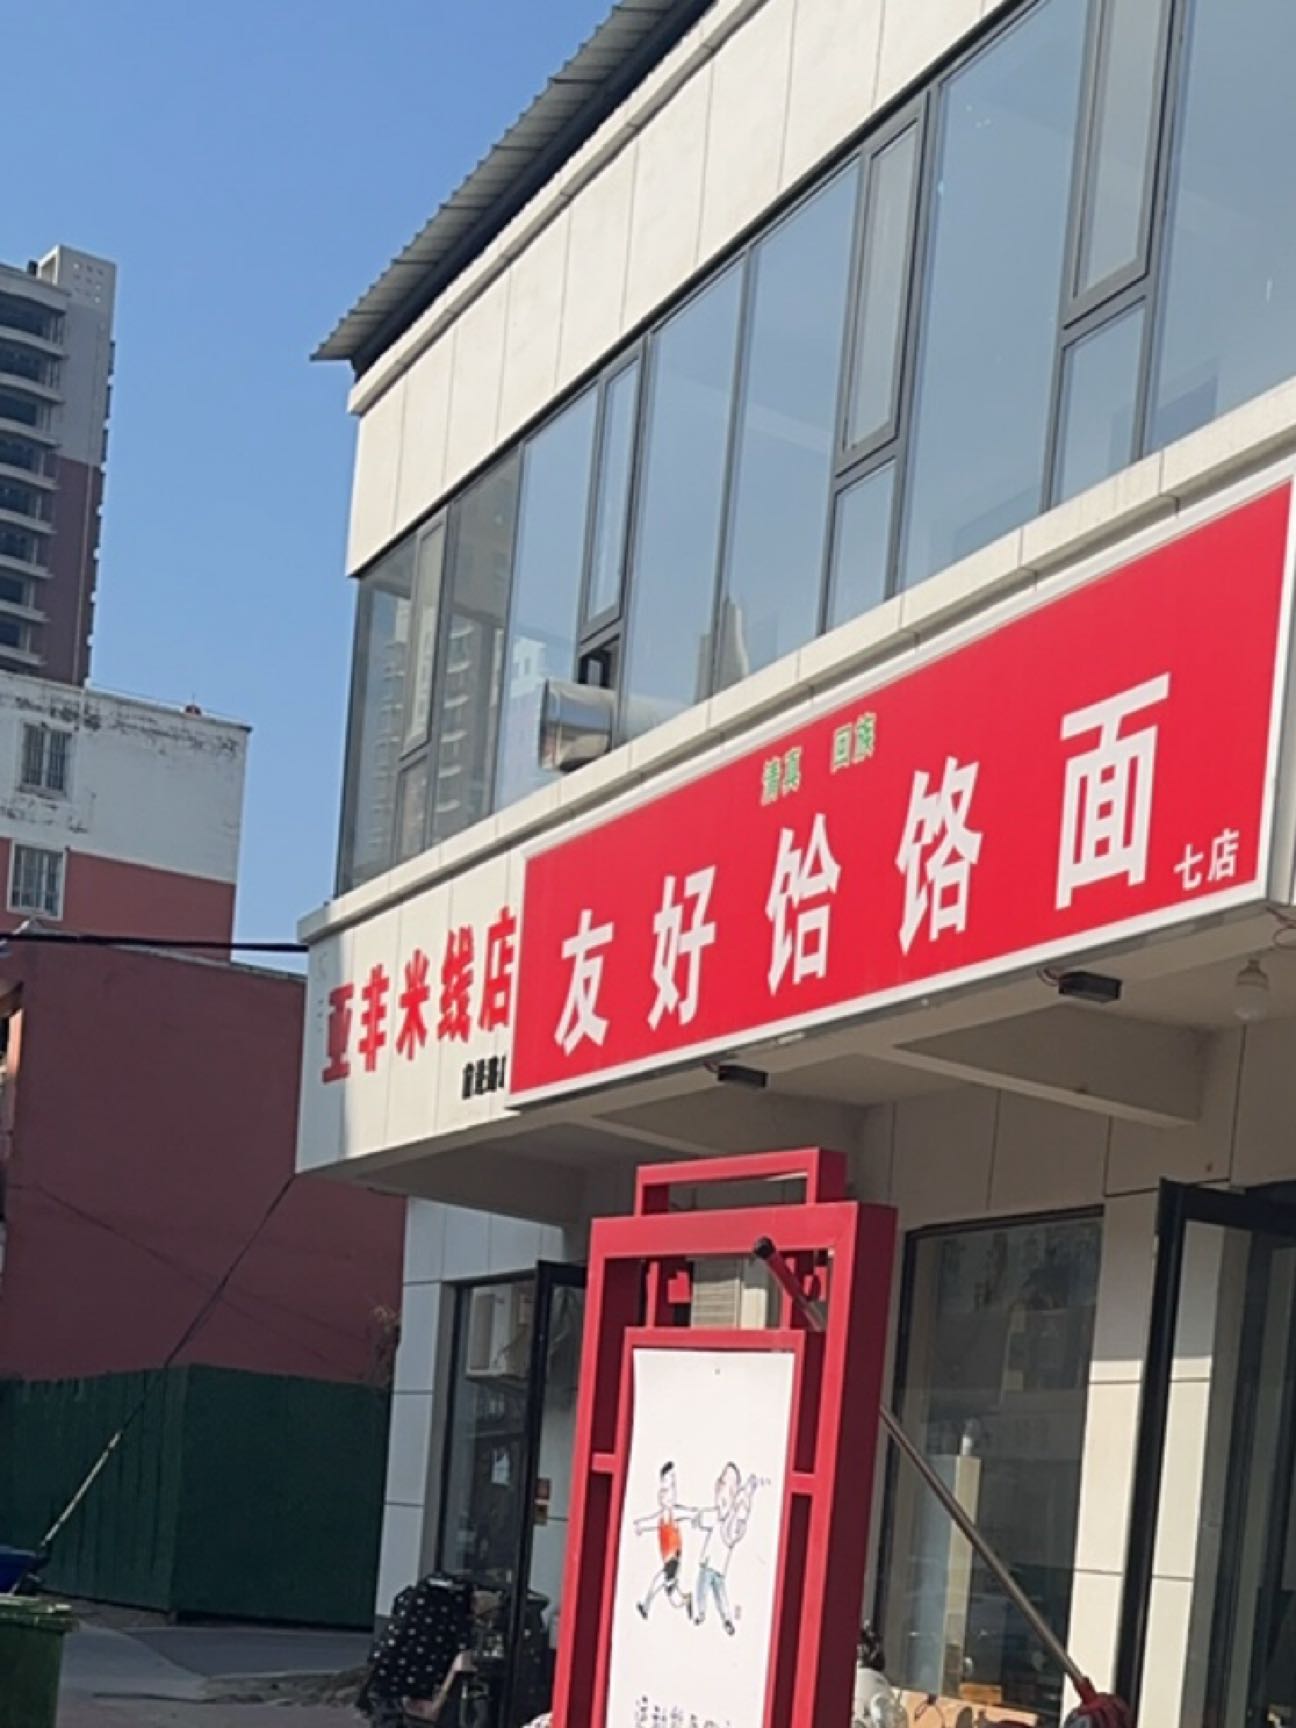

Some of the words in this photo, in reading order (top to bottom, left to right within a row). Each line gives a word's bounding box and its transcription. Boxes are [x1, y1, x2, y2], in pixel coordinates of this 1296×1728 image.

[553, 671, 1171, 1057] 友好饸饹面
[1173, 827, 1241, 891] 七店
